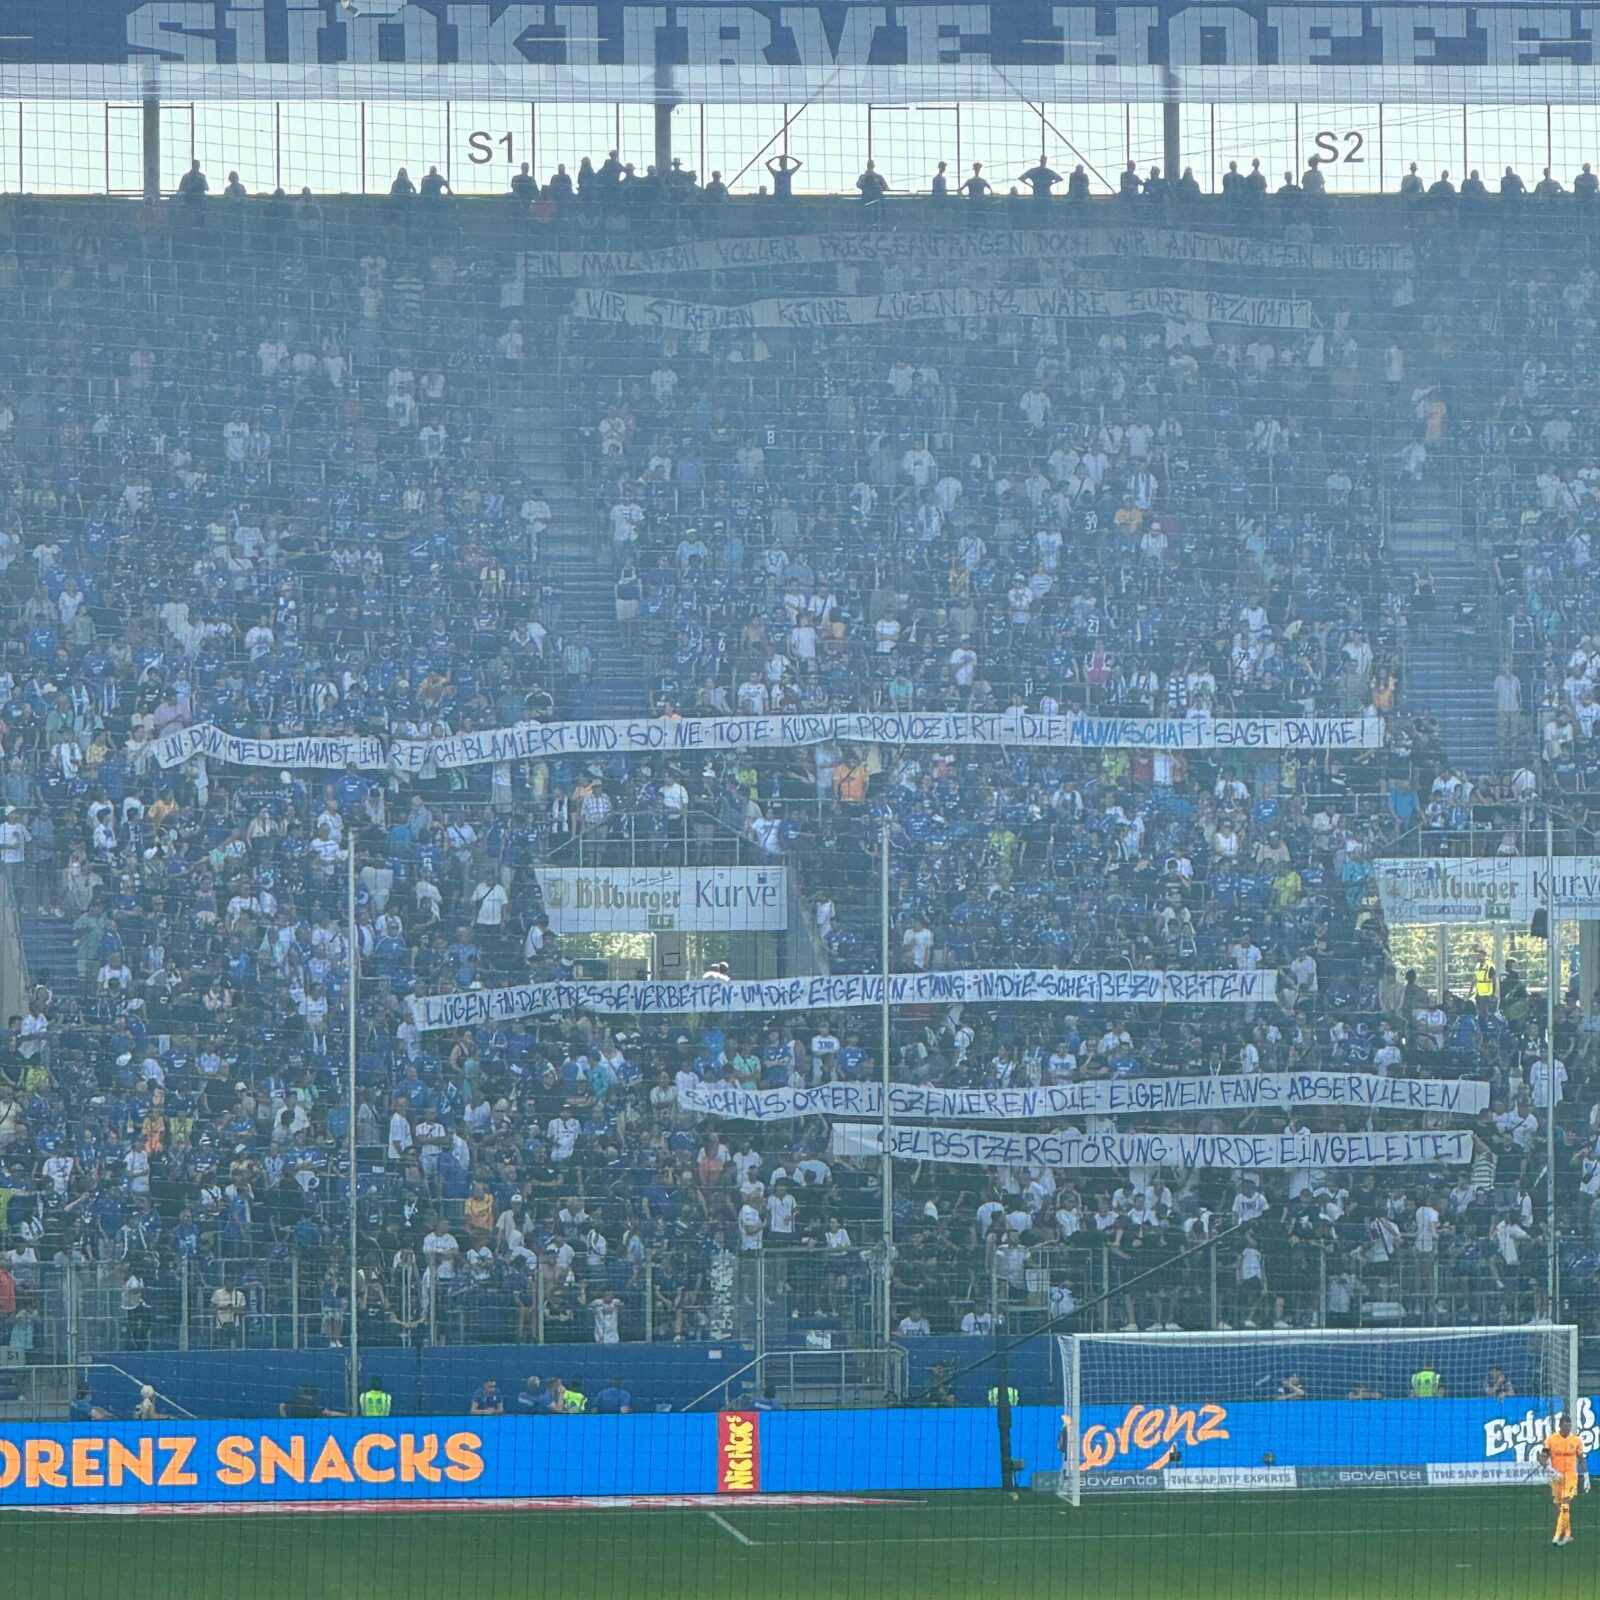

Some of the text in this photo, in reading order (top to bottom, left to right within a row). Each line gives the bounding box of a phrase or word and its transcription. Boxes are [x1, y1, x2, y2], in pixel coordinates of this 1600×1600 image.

[468, 131, 513, 164] S1
[1314, 131, 1364, 164] S2
[524, 251, 562, 276] EIN
[716, 237, 801, 262] VOLLER
[586, 290, 628, 323] WIR
[643, 299, 755, 331] STREUEN
[777, 298, 853, 326] KEINE
[1034, 288, 1108, 316] WÄRE
[1127, 290, 1191, 315] EURE
[576, 726, 618, 750] UND
[626, 723, 663, 748] SO
[715, 719, 770, 744] TOTE
[782, 715, 848, 743] KURVE
[1069, 718, 1211, 747] MANNSCHAFT
[1214, 721, 1275, 746] SAGT
[1285, 719, 1365, 747] DANKE!
[696, 879, 777, 908] Kurve
[427, 994, 491, 1026] LÜGEN
[519, 990, 552, 1013] DER
[556, 983, 631, 1012] PRESSE
[739, 986, 765, 1006] UM
[917, 972, 966, 999] FANS
[743, 1089, 785, 1119] ALS
[793, 1082, 860, 1112] OPFER
[1220, 1074, 1277, 1107] FANS
[1286, 1074, 1459, 1112] ABSERVIEREN
[1180, 1135, 1266, 1167] WURDE
[216, 1432, 485, 1485] SNACKS
[1457, 1469, 1480, 1479] SAP
[1195, 1474, 1217, 1484] SAP
[1243, 1472, 1291, 1484] EXPERTS
